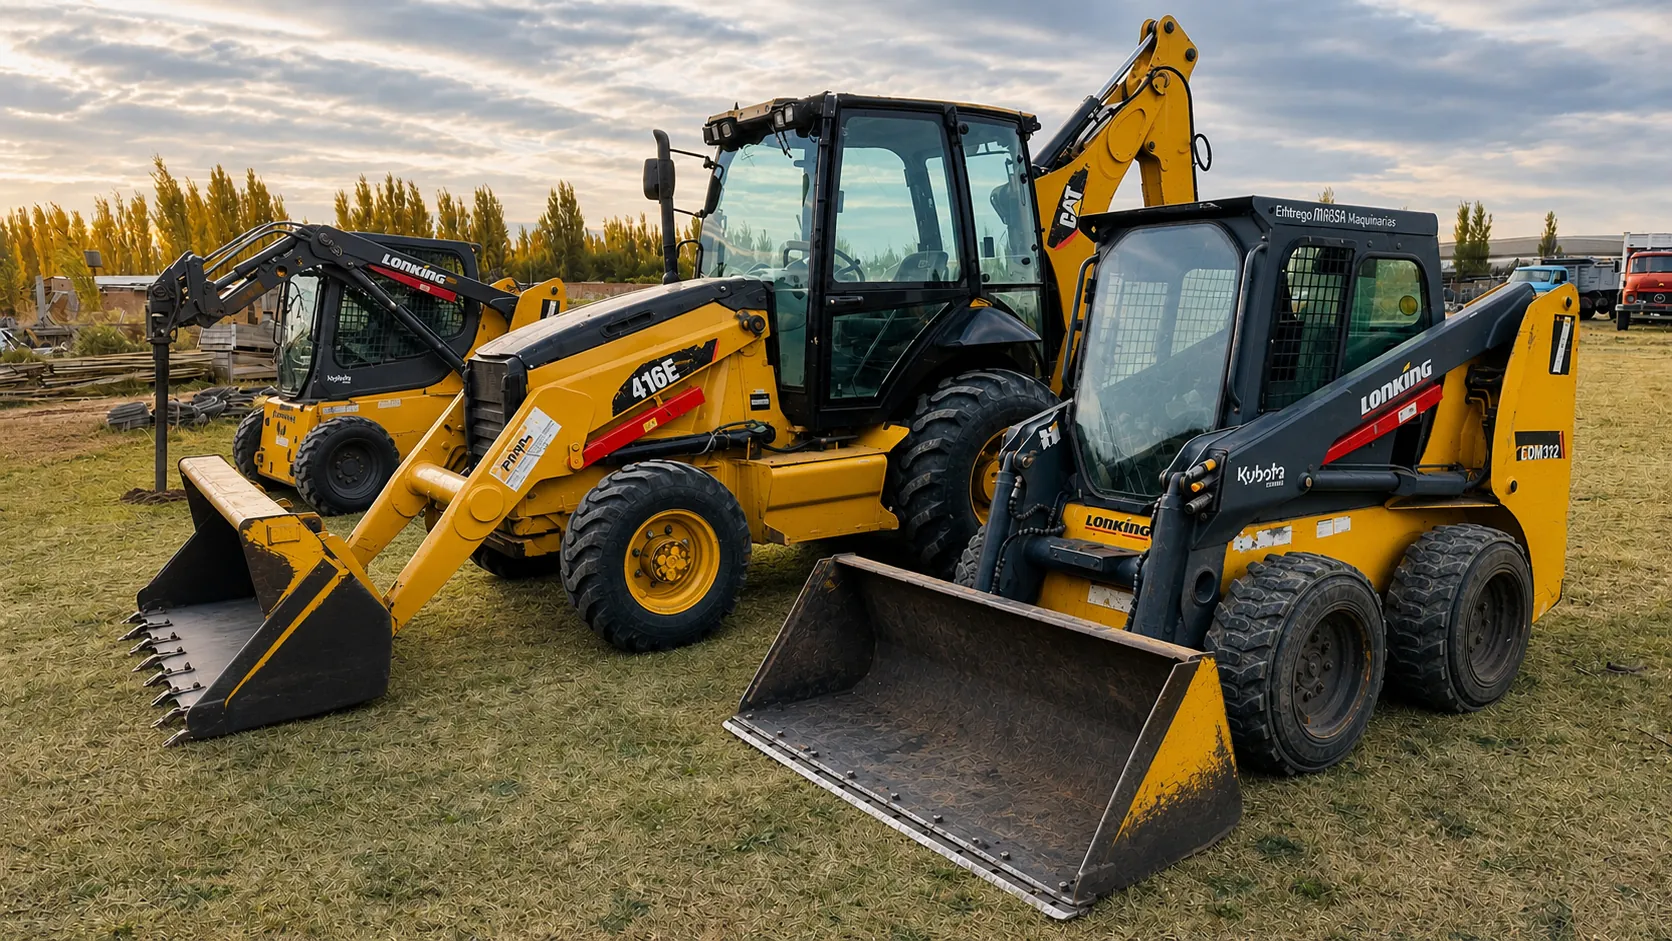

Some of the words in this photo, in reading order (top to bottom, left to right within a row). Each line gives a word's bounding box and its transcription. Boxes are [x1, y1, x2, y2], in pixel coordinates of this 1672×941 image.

[1060, 185, 1083, 229] CAT
[381, 253, 447, 285] LONKING
[632, 358, 680, 399] 416E
[1361, 359, 1432, 416] LONKING
[1085, 515, 1151, 537] LONKING
